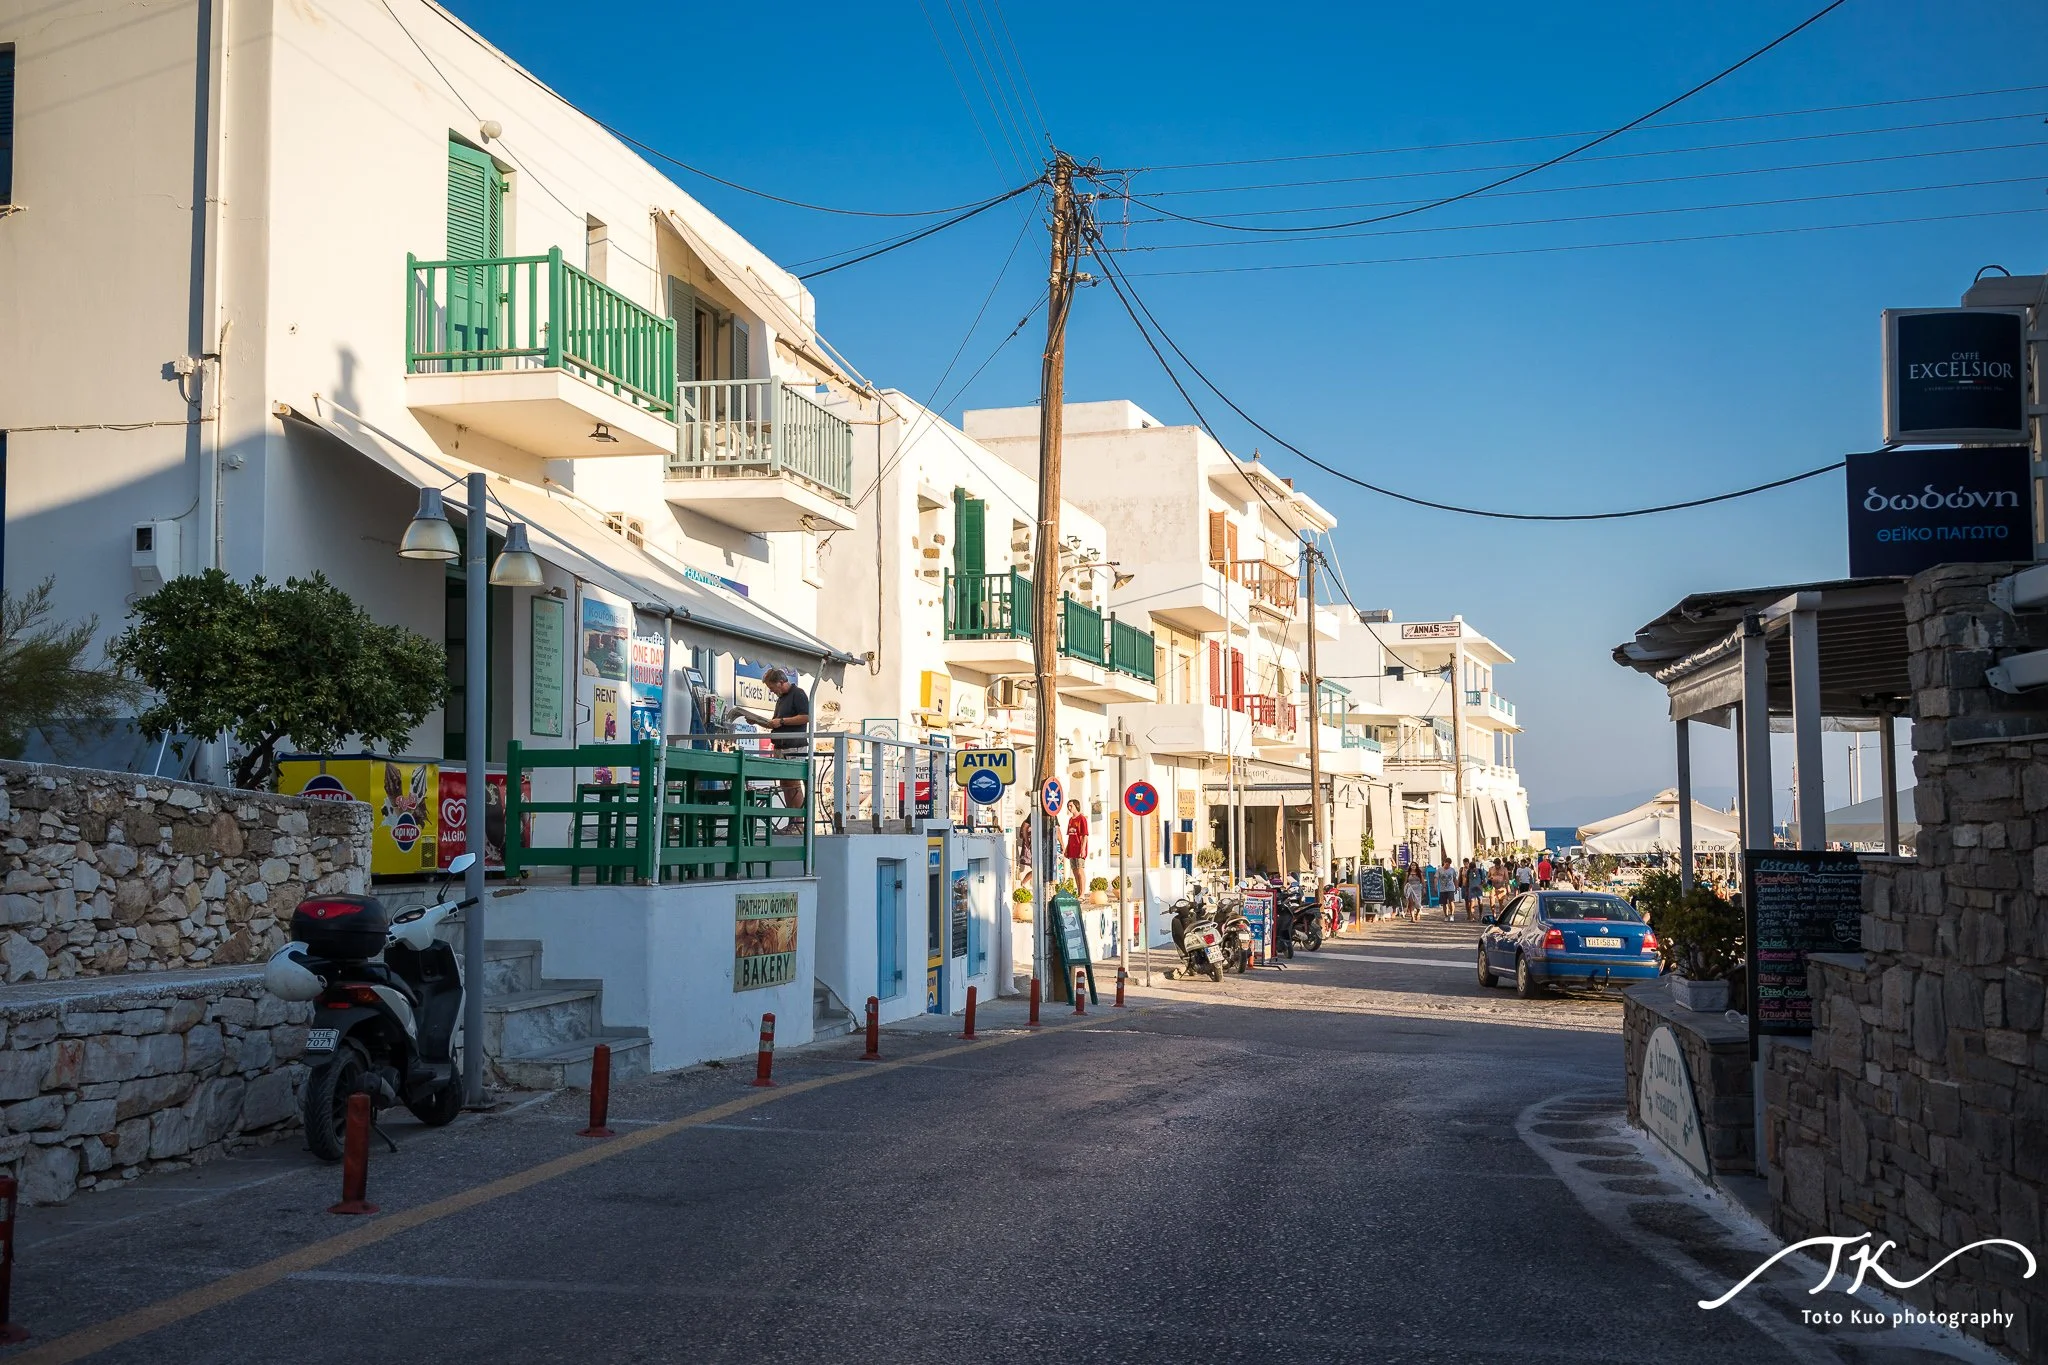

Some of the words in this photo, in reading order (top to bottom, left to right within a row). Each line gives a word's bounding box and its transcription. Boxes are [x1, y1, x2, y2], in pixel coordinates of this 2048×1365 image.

[1908, 361, 2014, 380] EXCELSIOR
[1863, 484, 2020, 512] δωδώνη
[1937, 525, 2009, 541] ΠΑΓΩΤΟ
[633, 644, 648, 663] ONE
[650, 647, 665, 665] DAY
[633, 665, 663, 687] CRUISES
[595, 687, 617, 704] RENT
[739, 681, 763, 700] Tickets
[962, 753, 1008, 768] ATM
[441, 831, 466, 842] ALGID
[742, 954, 790, 987] BAKERY
